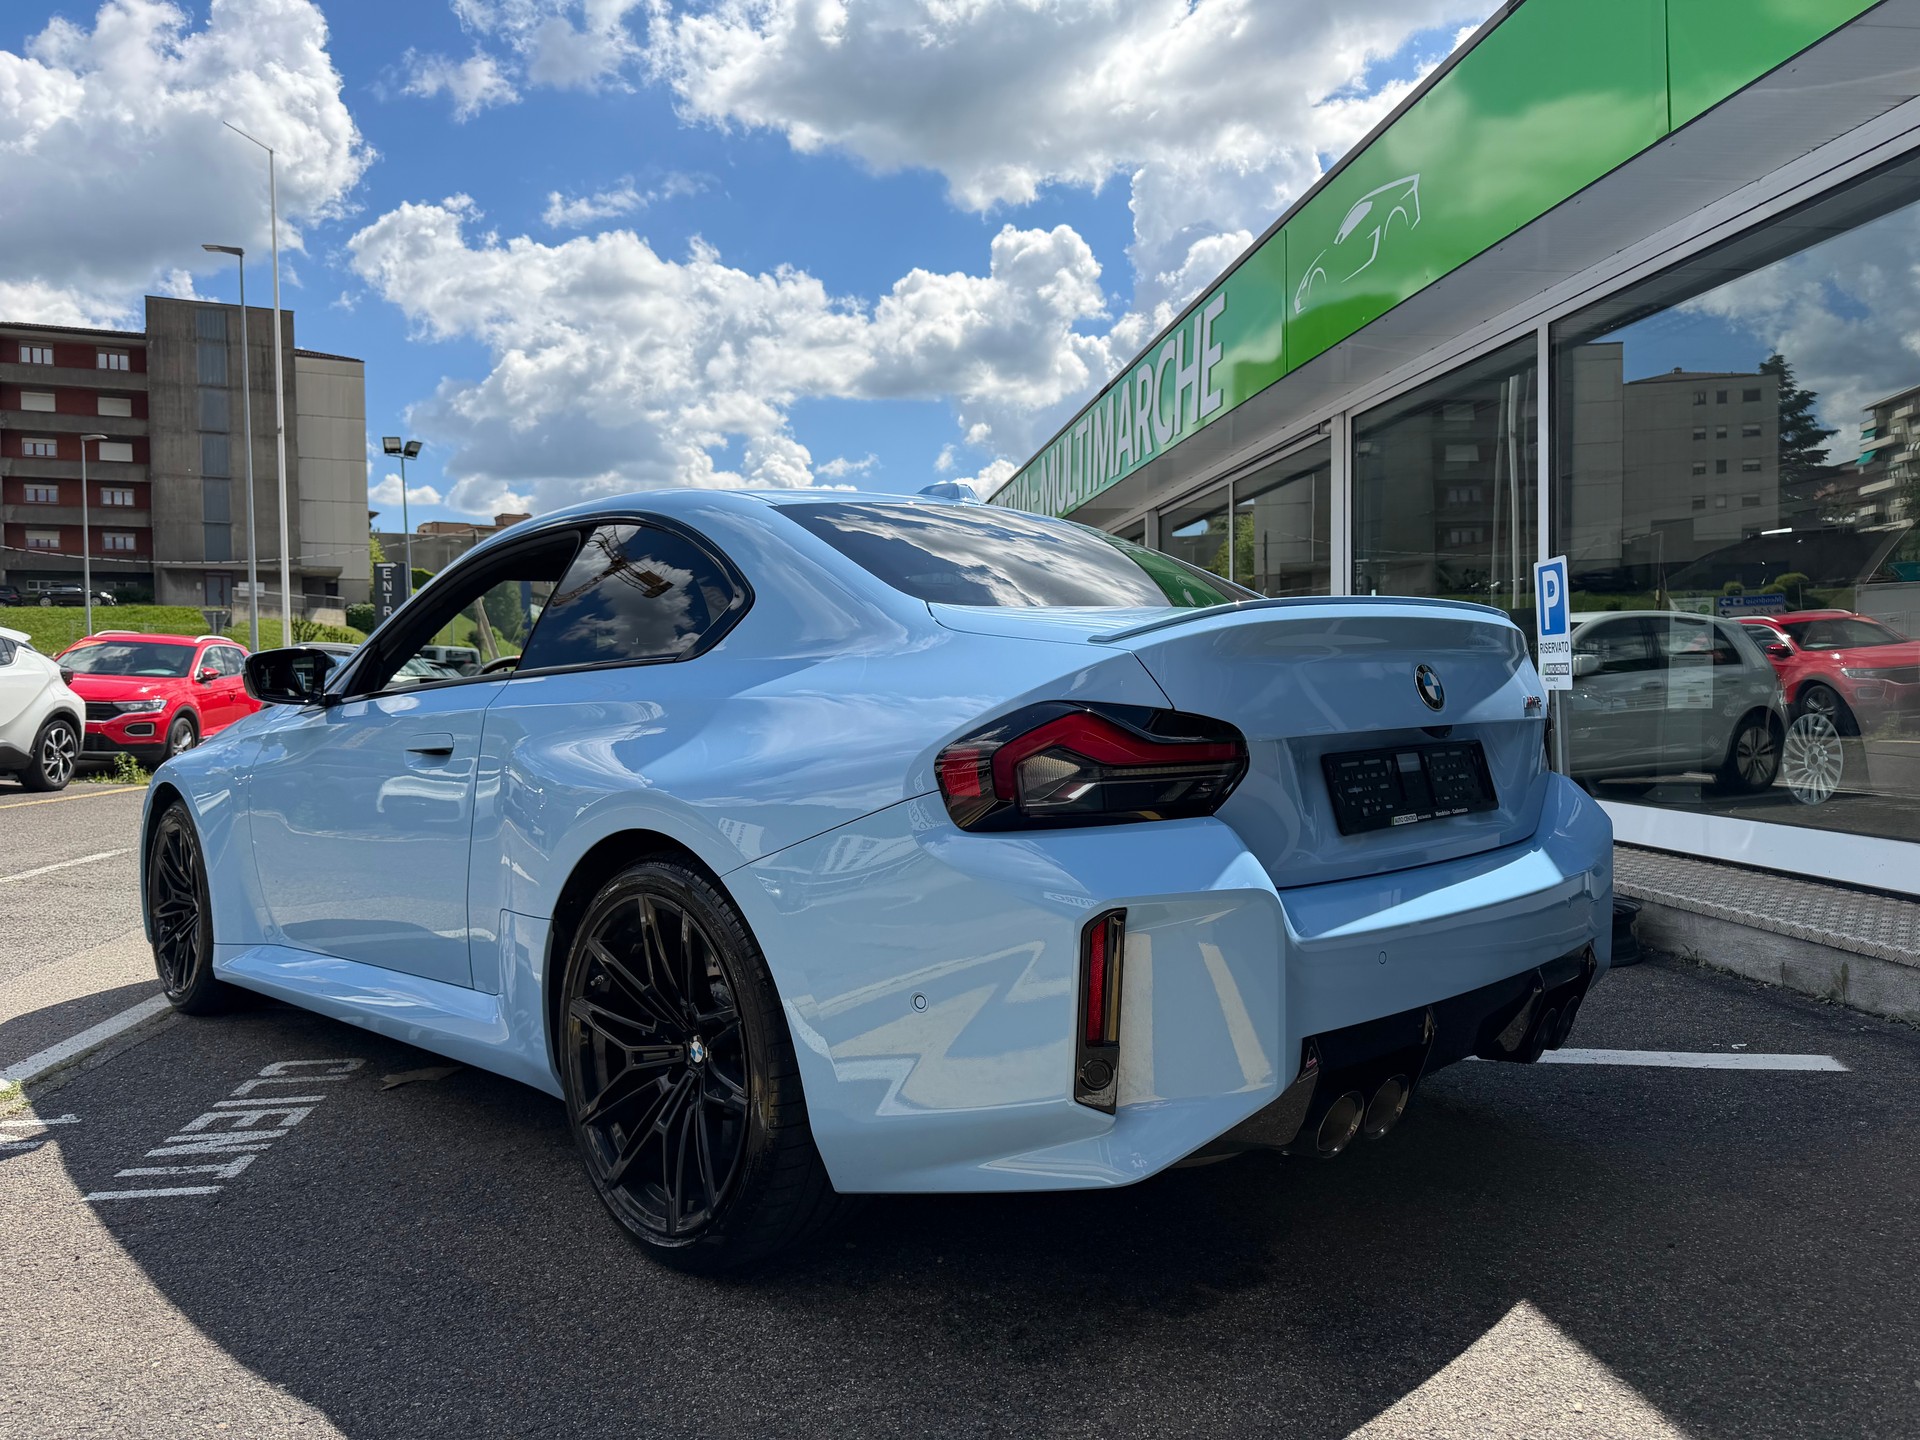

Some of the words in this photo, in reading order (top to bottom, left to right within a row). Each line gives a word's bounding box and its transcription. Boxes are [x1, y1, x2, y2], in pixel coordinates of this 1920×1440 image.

[1541, 570, 1560, 631] P
[1540, 641, 1570, 654] RISERVATO
[84, 1057, 366, 1202] CLIENTI
